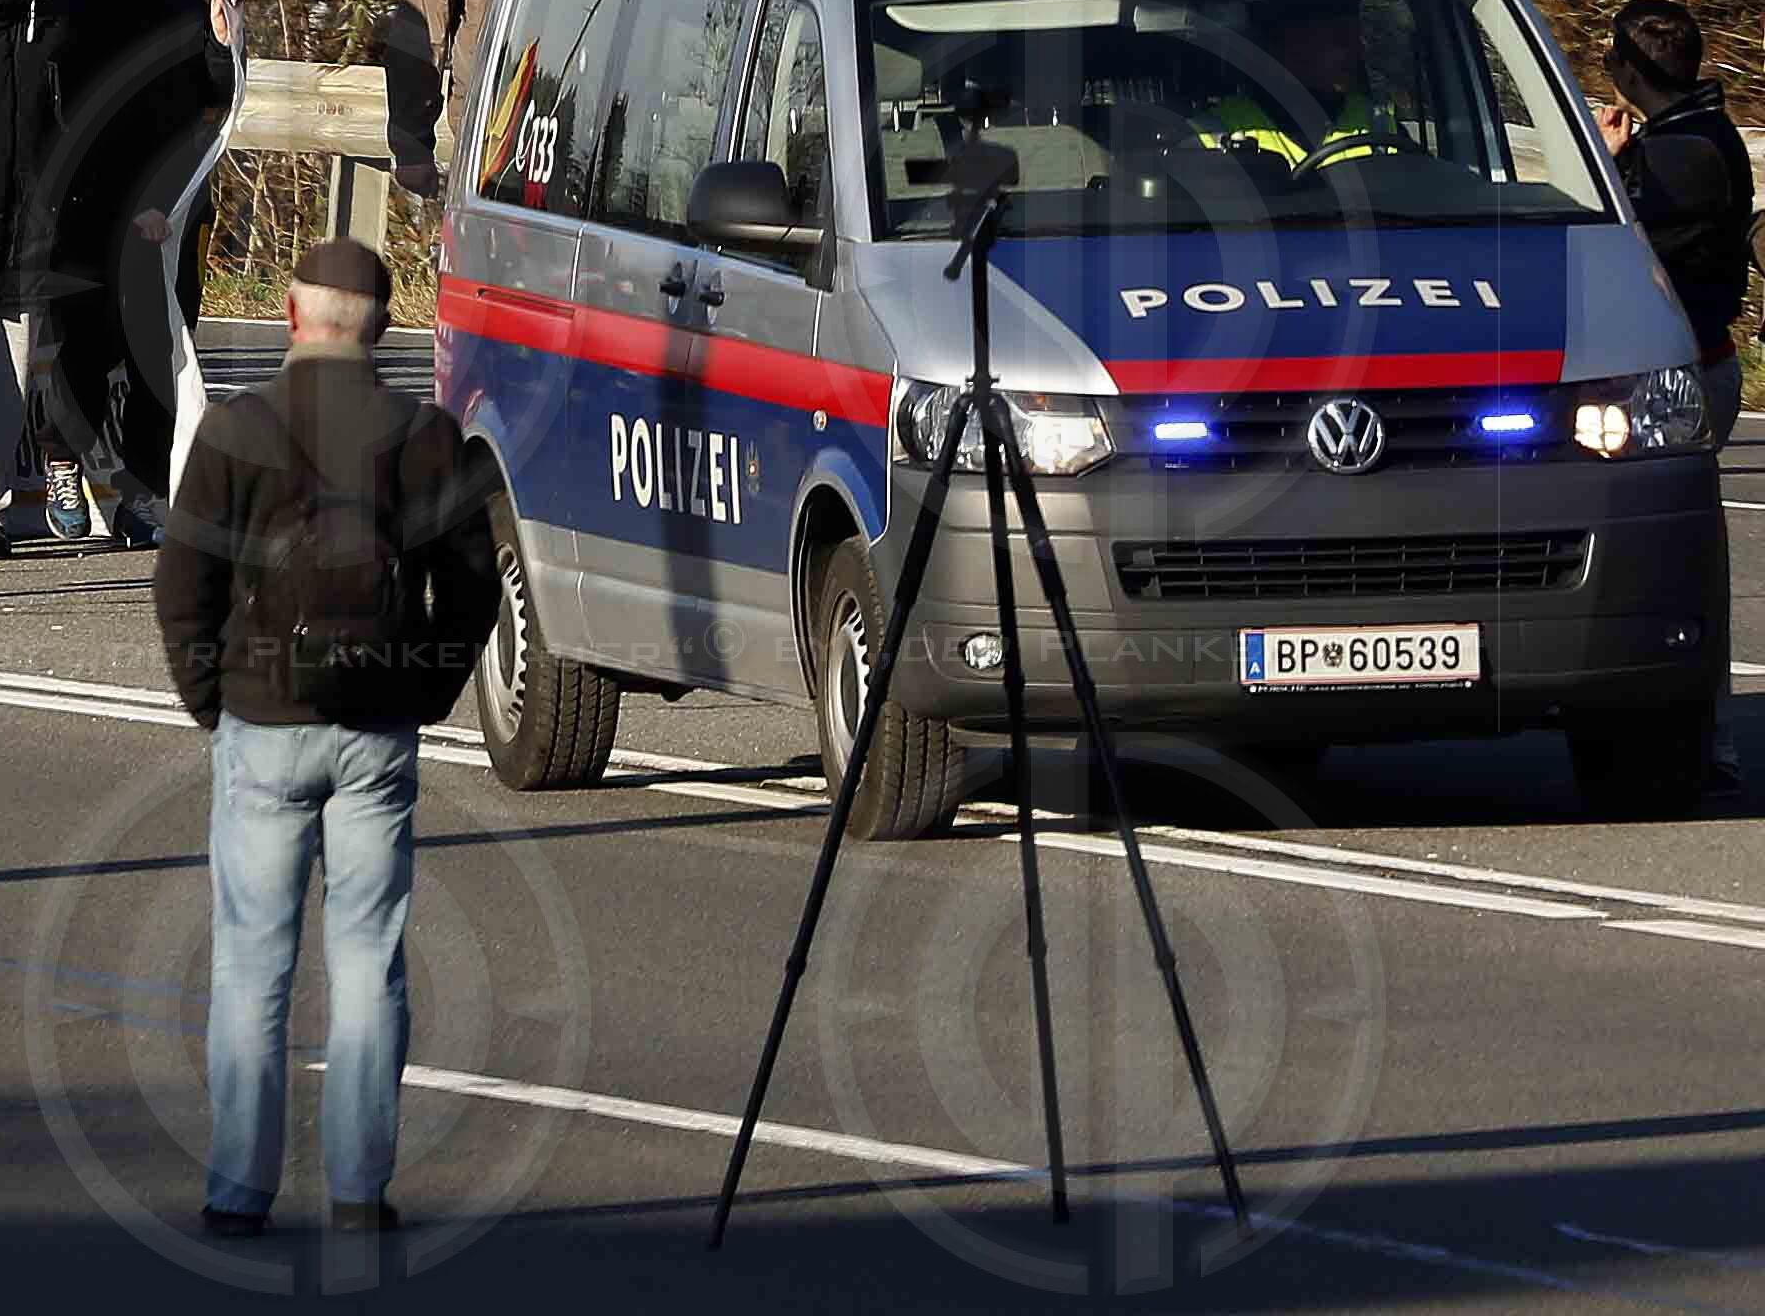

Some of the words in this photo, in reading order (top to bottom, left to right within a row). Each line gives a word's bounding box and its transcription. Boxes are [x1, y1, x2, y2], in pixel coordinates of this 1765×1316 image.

[528, 115, 559, 184] 133
[1120, 279, 1501, 319] POLIZEI
[610, 413, 741, 525] POLIZEI
[1277, 640, 1318, 673] BP
[1349, 637, 1460, 671] 60539
